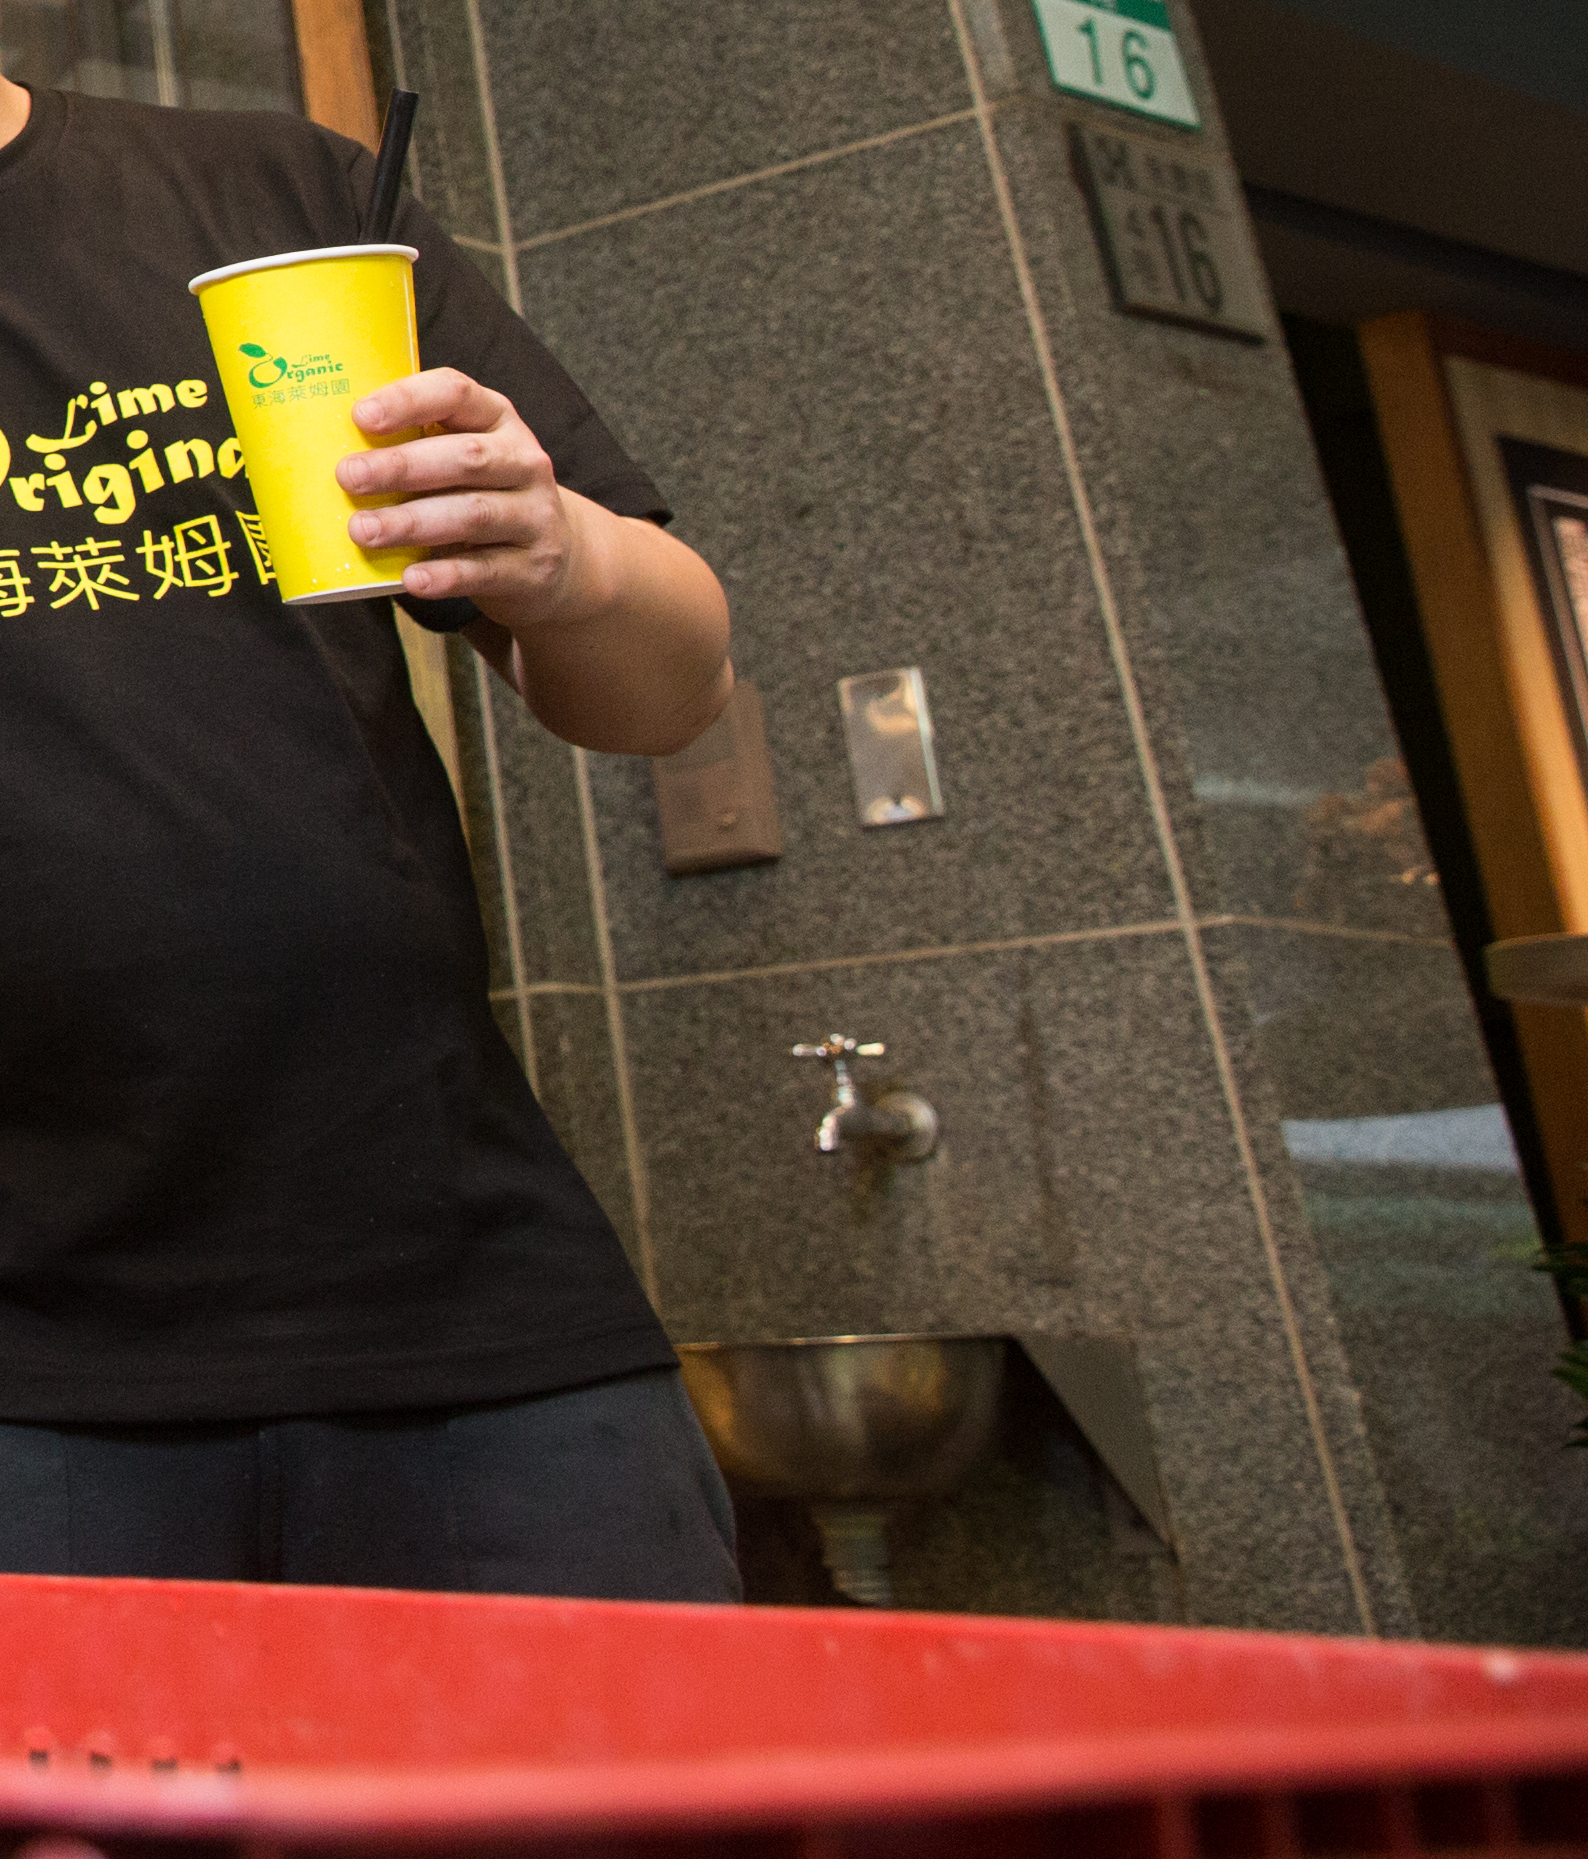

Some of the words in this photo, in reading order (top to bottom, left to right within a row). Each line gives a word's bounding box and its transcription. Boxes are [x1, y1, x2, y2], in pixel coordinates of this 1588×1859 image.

[1076, 14, 1158, 101] 16
[25, 379, 209, 454] Lime
[251, 378, 351, 410] 東海萊姆園
